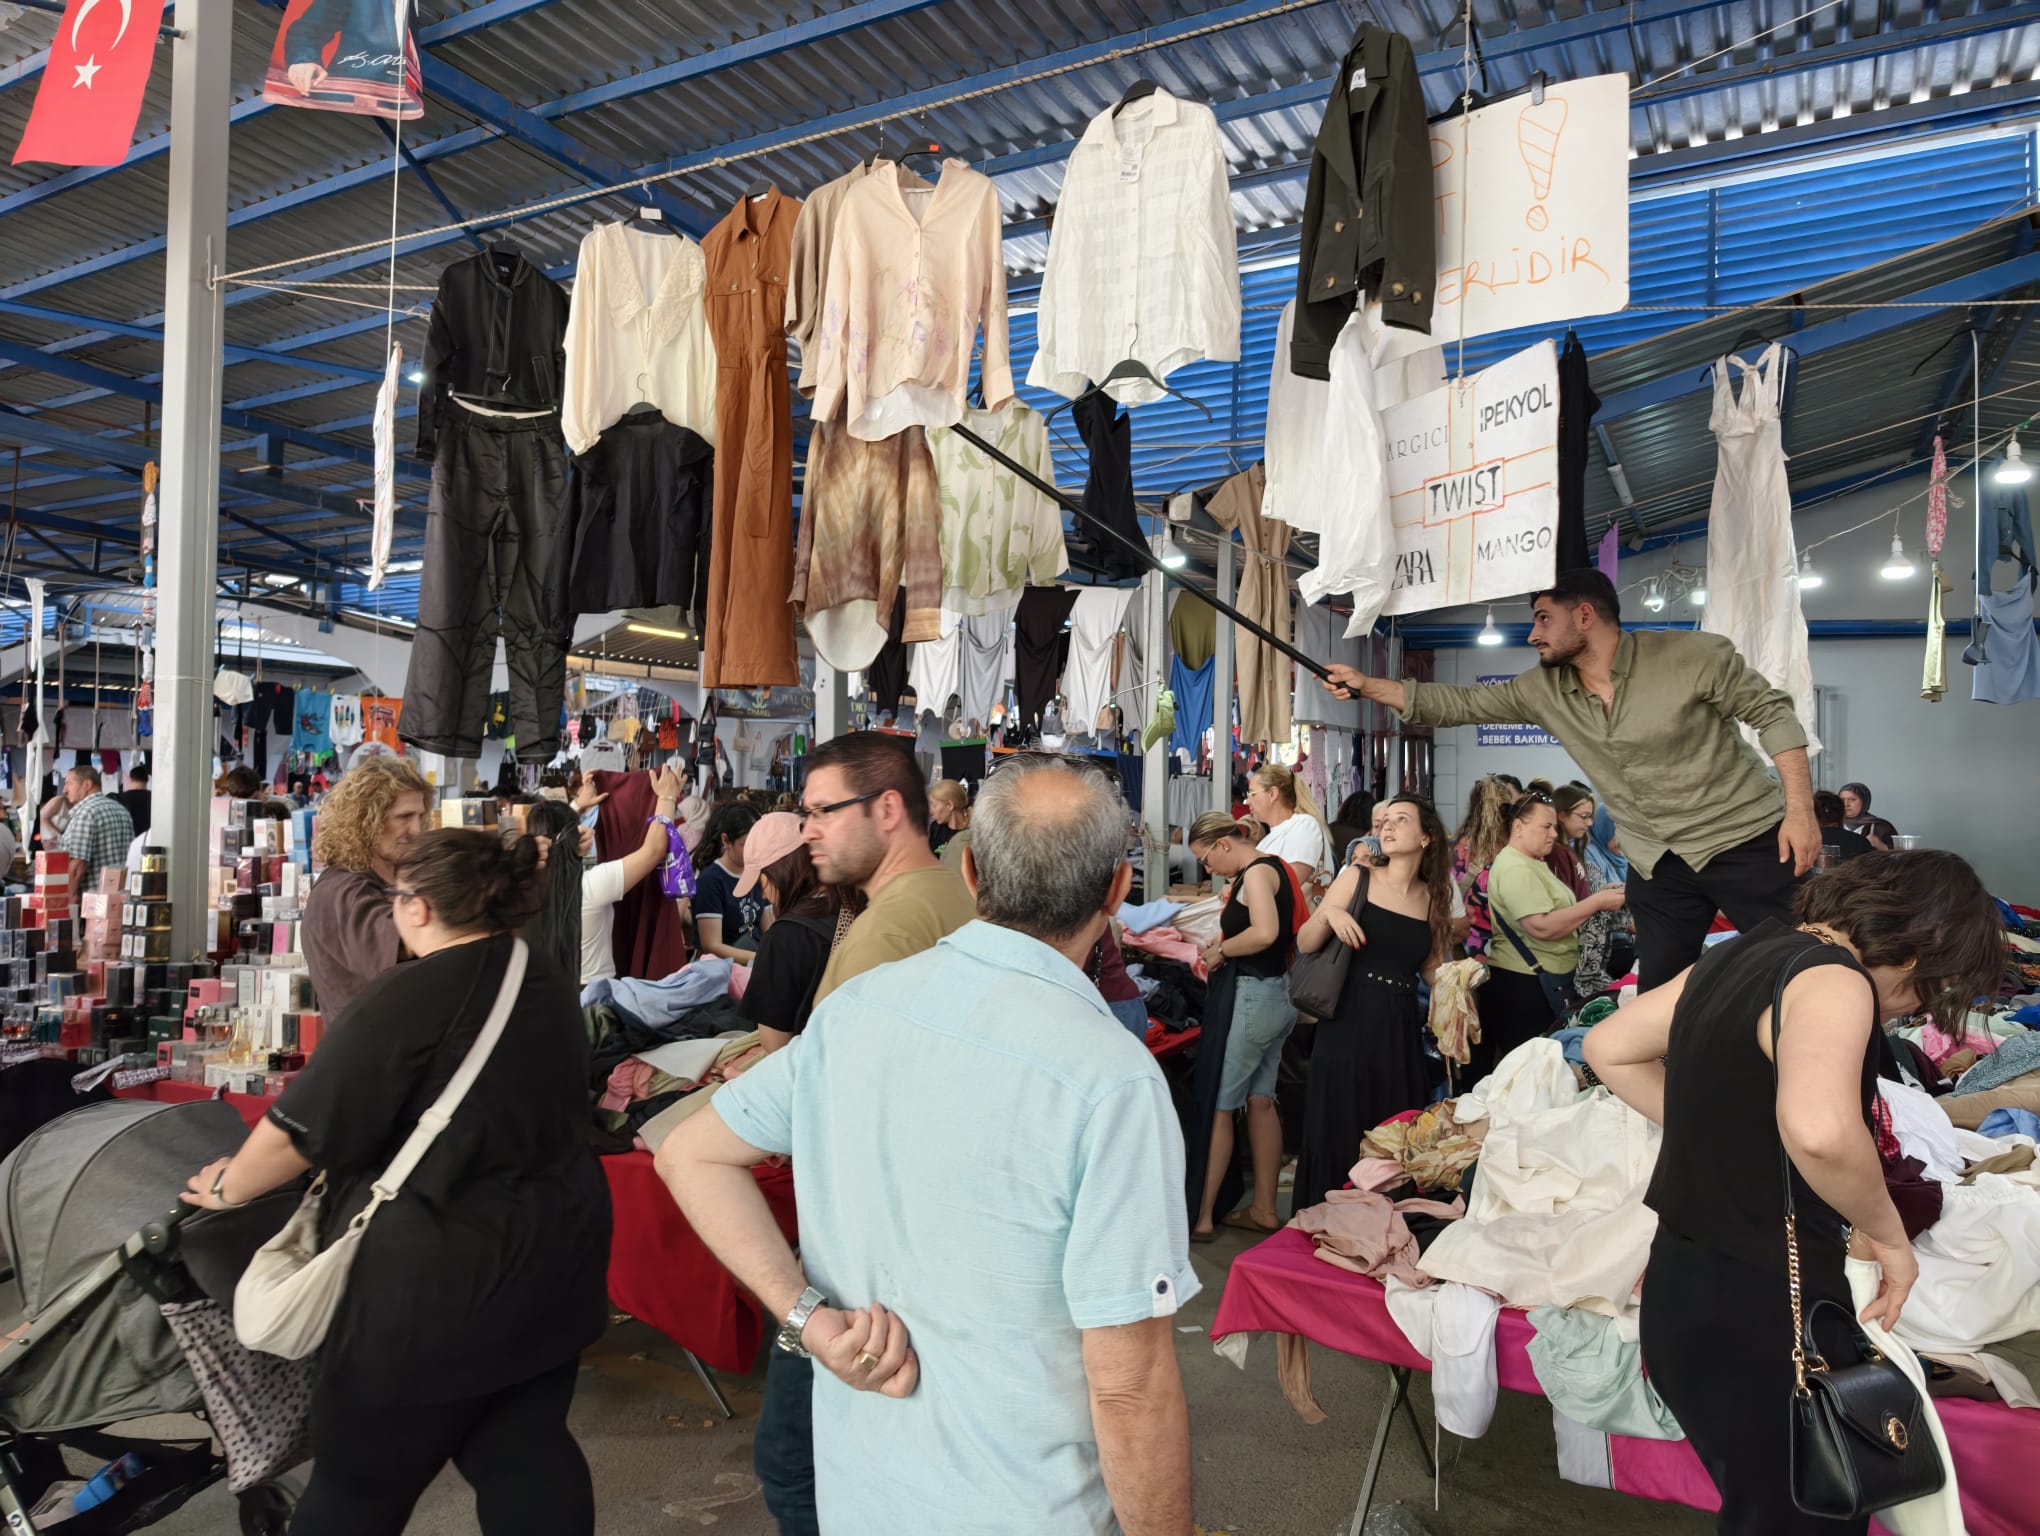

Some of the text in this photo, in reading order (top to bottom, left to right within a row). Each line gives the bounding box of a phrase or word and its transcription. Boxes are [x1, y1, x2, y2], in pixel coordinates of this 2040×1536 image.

[1429, 465, 1501, 516] TWIST
[1477, 526, 1552, 562] MANGO
[1391, 547, 1437, 591] ZARA
[1482, 735, 1511, 744] BEBEK
[1514, 735, 1547, 744] BAKIM
